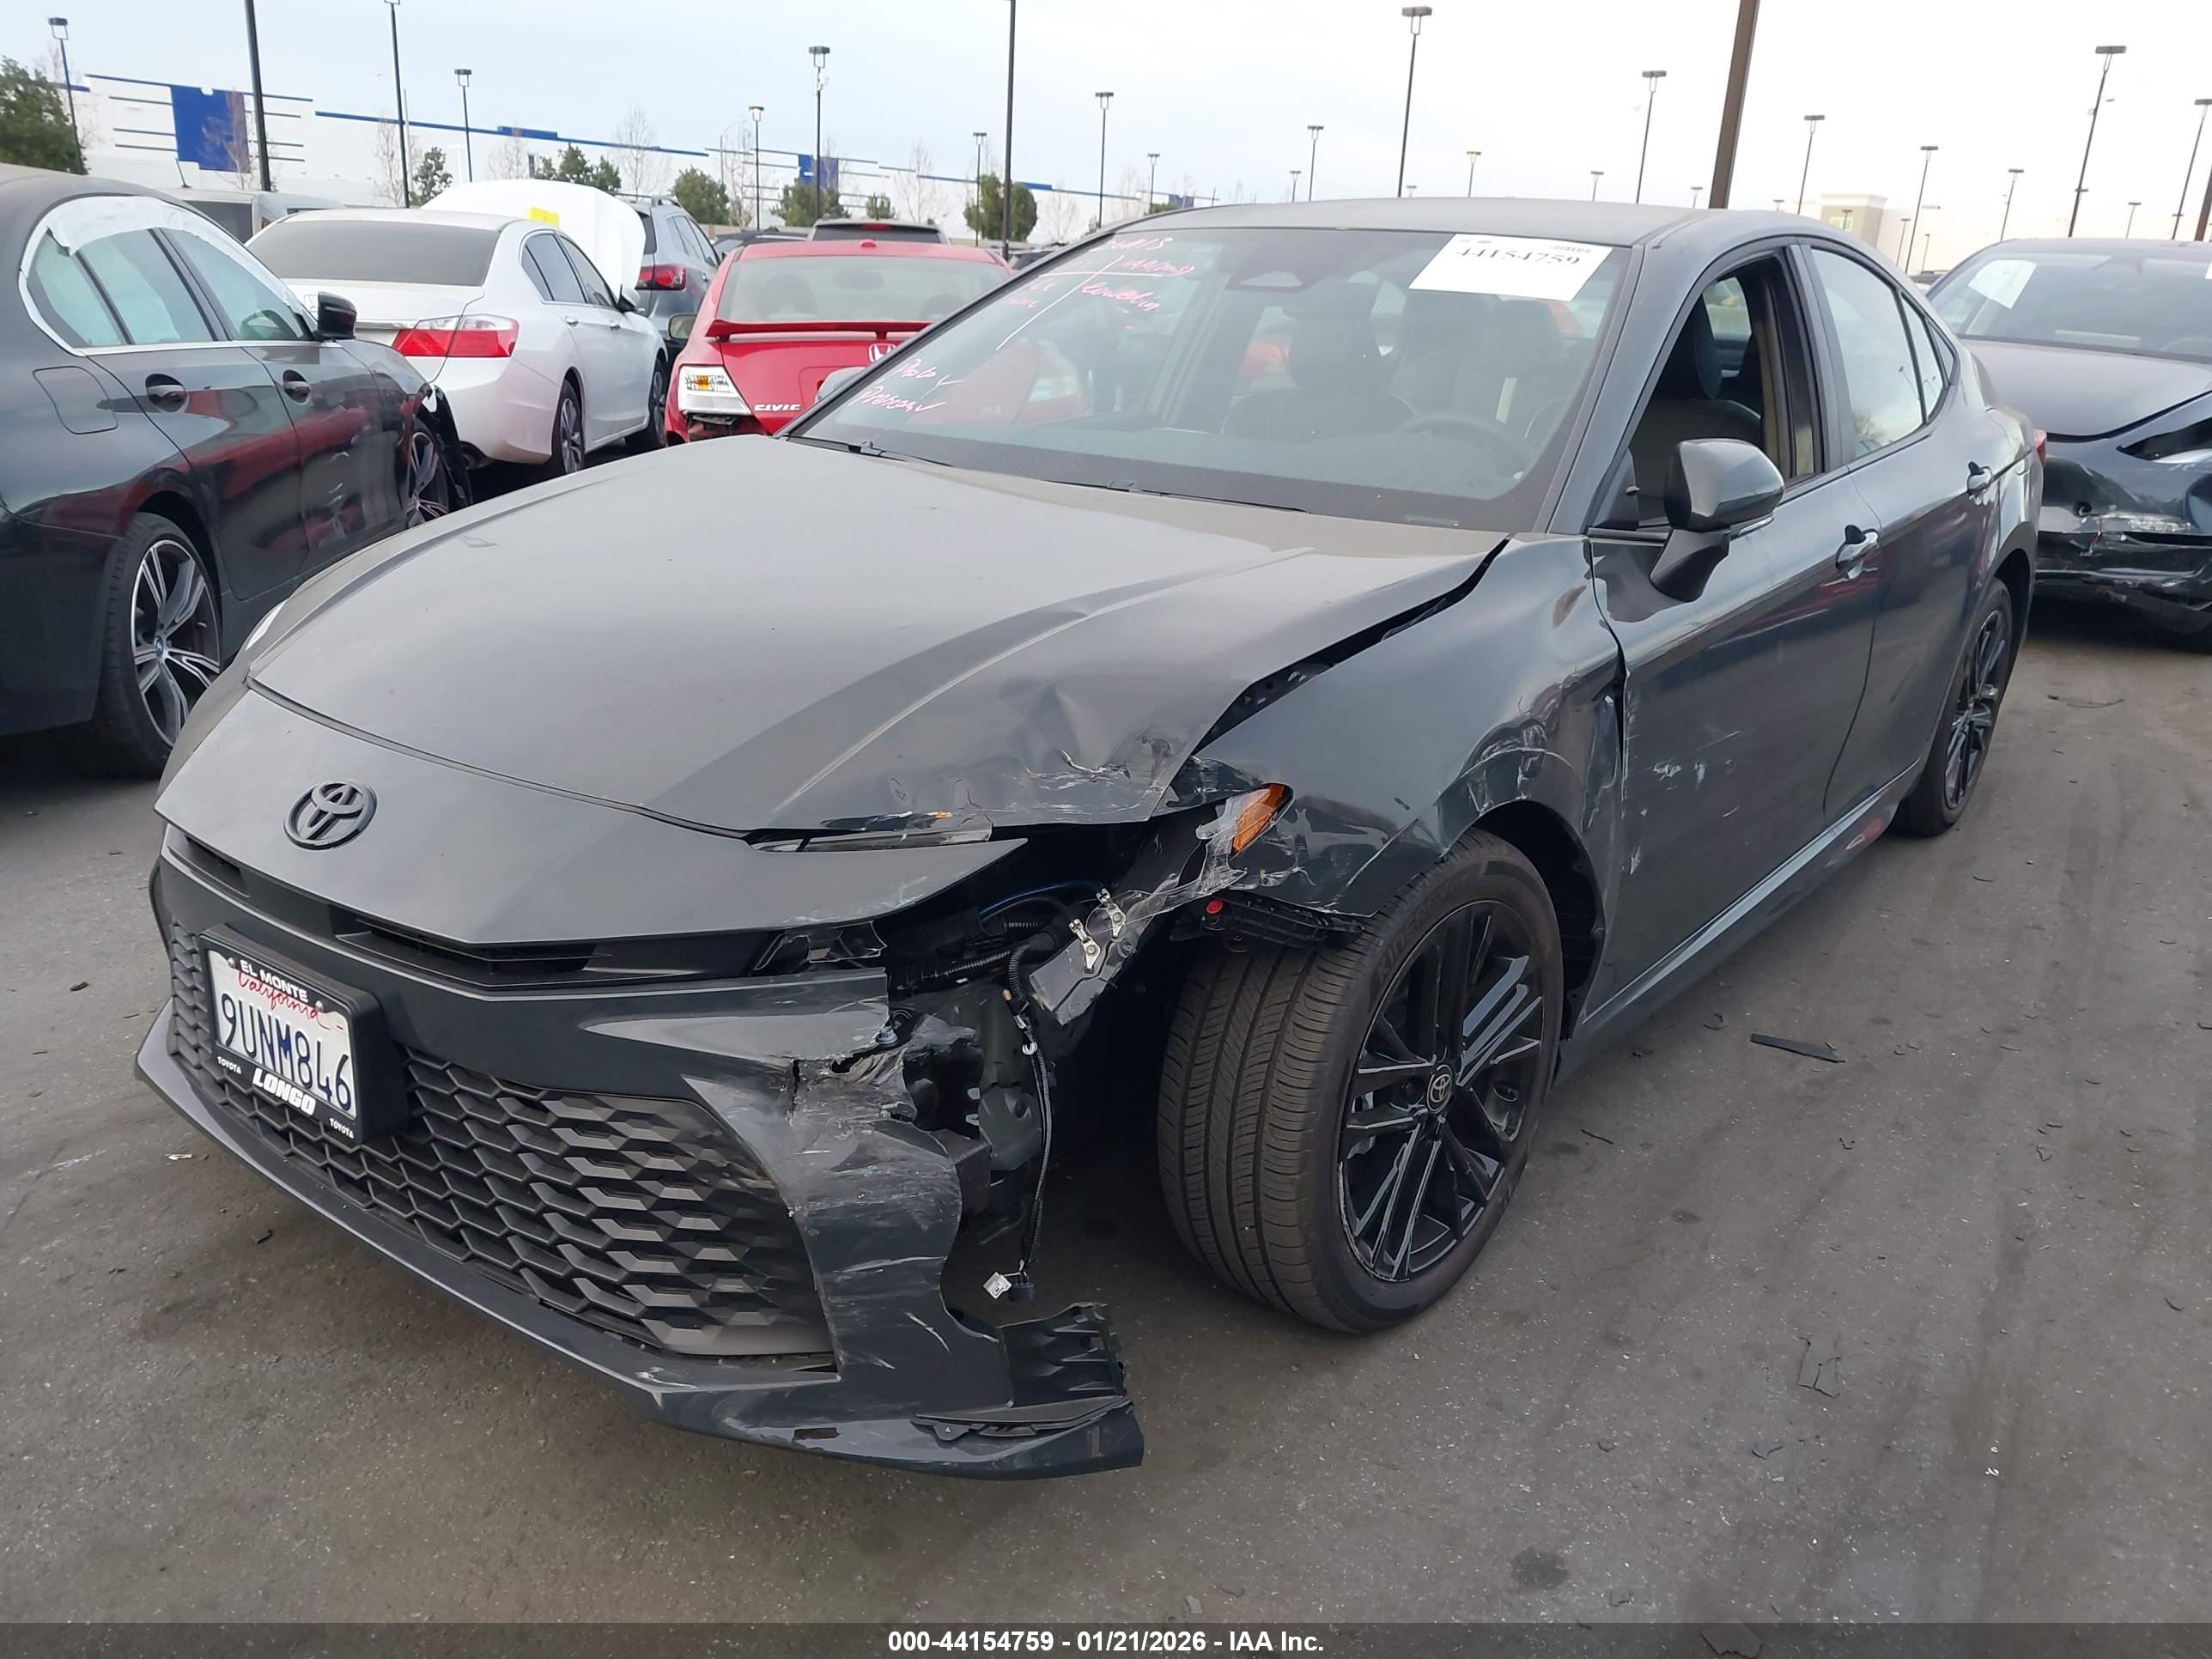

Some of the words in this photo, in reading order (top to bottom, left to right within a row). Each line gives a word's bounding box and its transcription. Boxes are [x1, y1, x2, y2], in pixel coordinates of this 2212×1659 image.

[1456, 247, 1581, 264] 44154759
[753, 403, 802, 412] CIVIC
[240, 959, 258, 978] EL
[259, 969, 308, 1004] MONTE
[222, 993, 351, 1111] 9UNM846
[216, 1056, 242, 1074] TOYOTA
[252, 1067, 317, 1116] LONGO
[329, 1117, 355, 1139] TOYOTA
